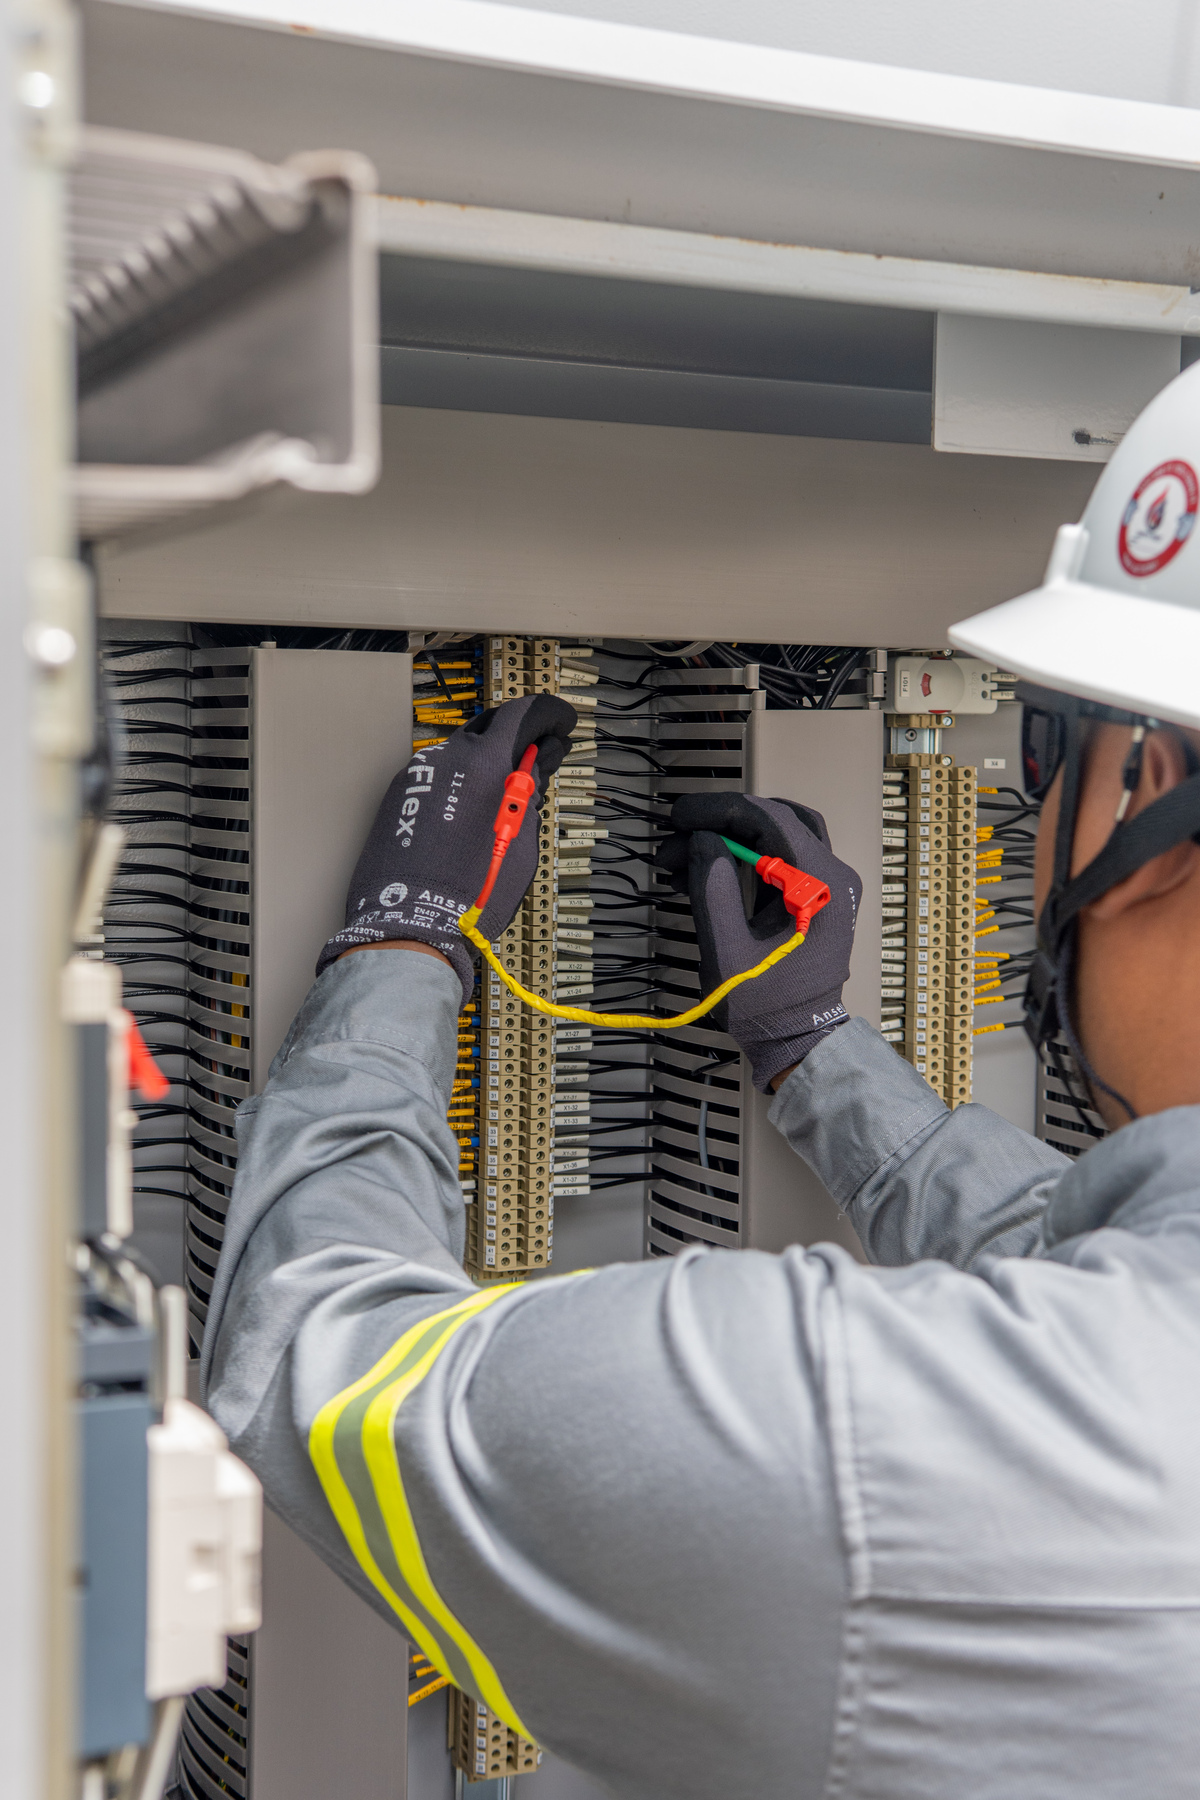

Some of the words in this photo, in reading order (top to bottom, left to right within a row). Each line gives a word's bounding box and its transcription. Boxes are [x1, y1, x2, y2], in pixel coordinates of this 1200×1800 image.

[443, 771, 466, 821] 11-840
[414, 906, 441, 919] EN407
[418, 889, 468, 913] Anse
